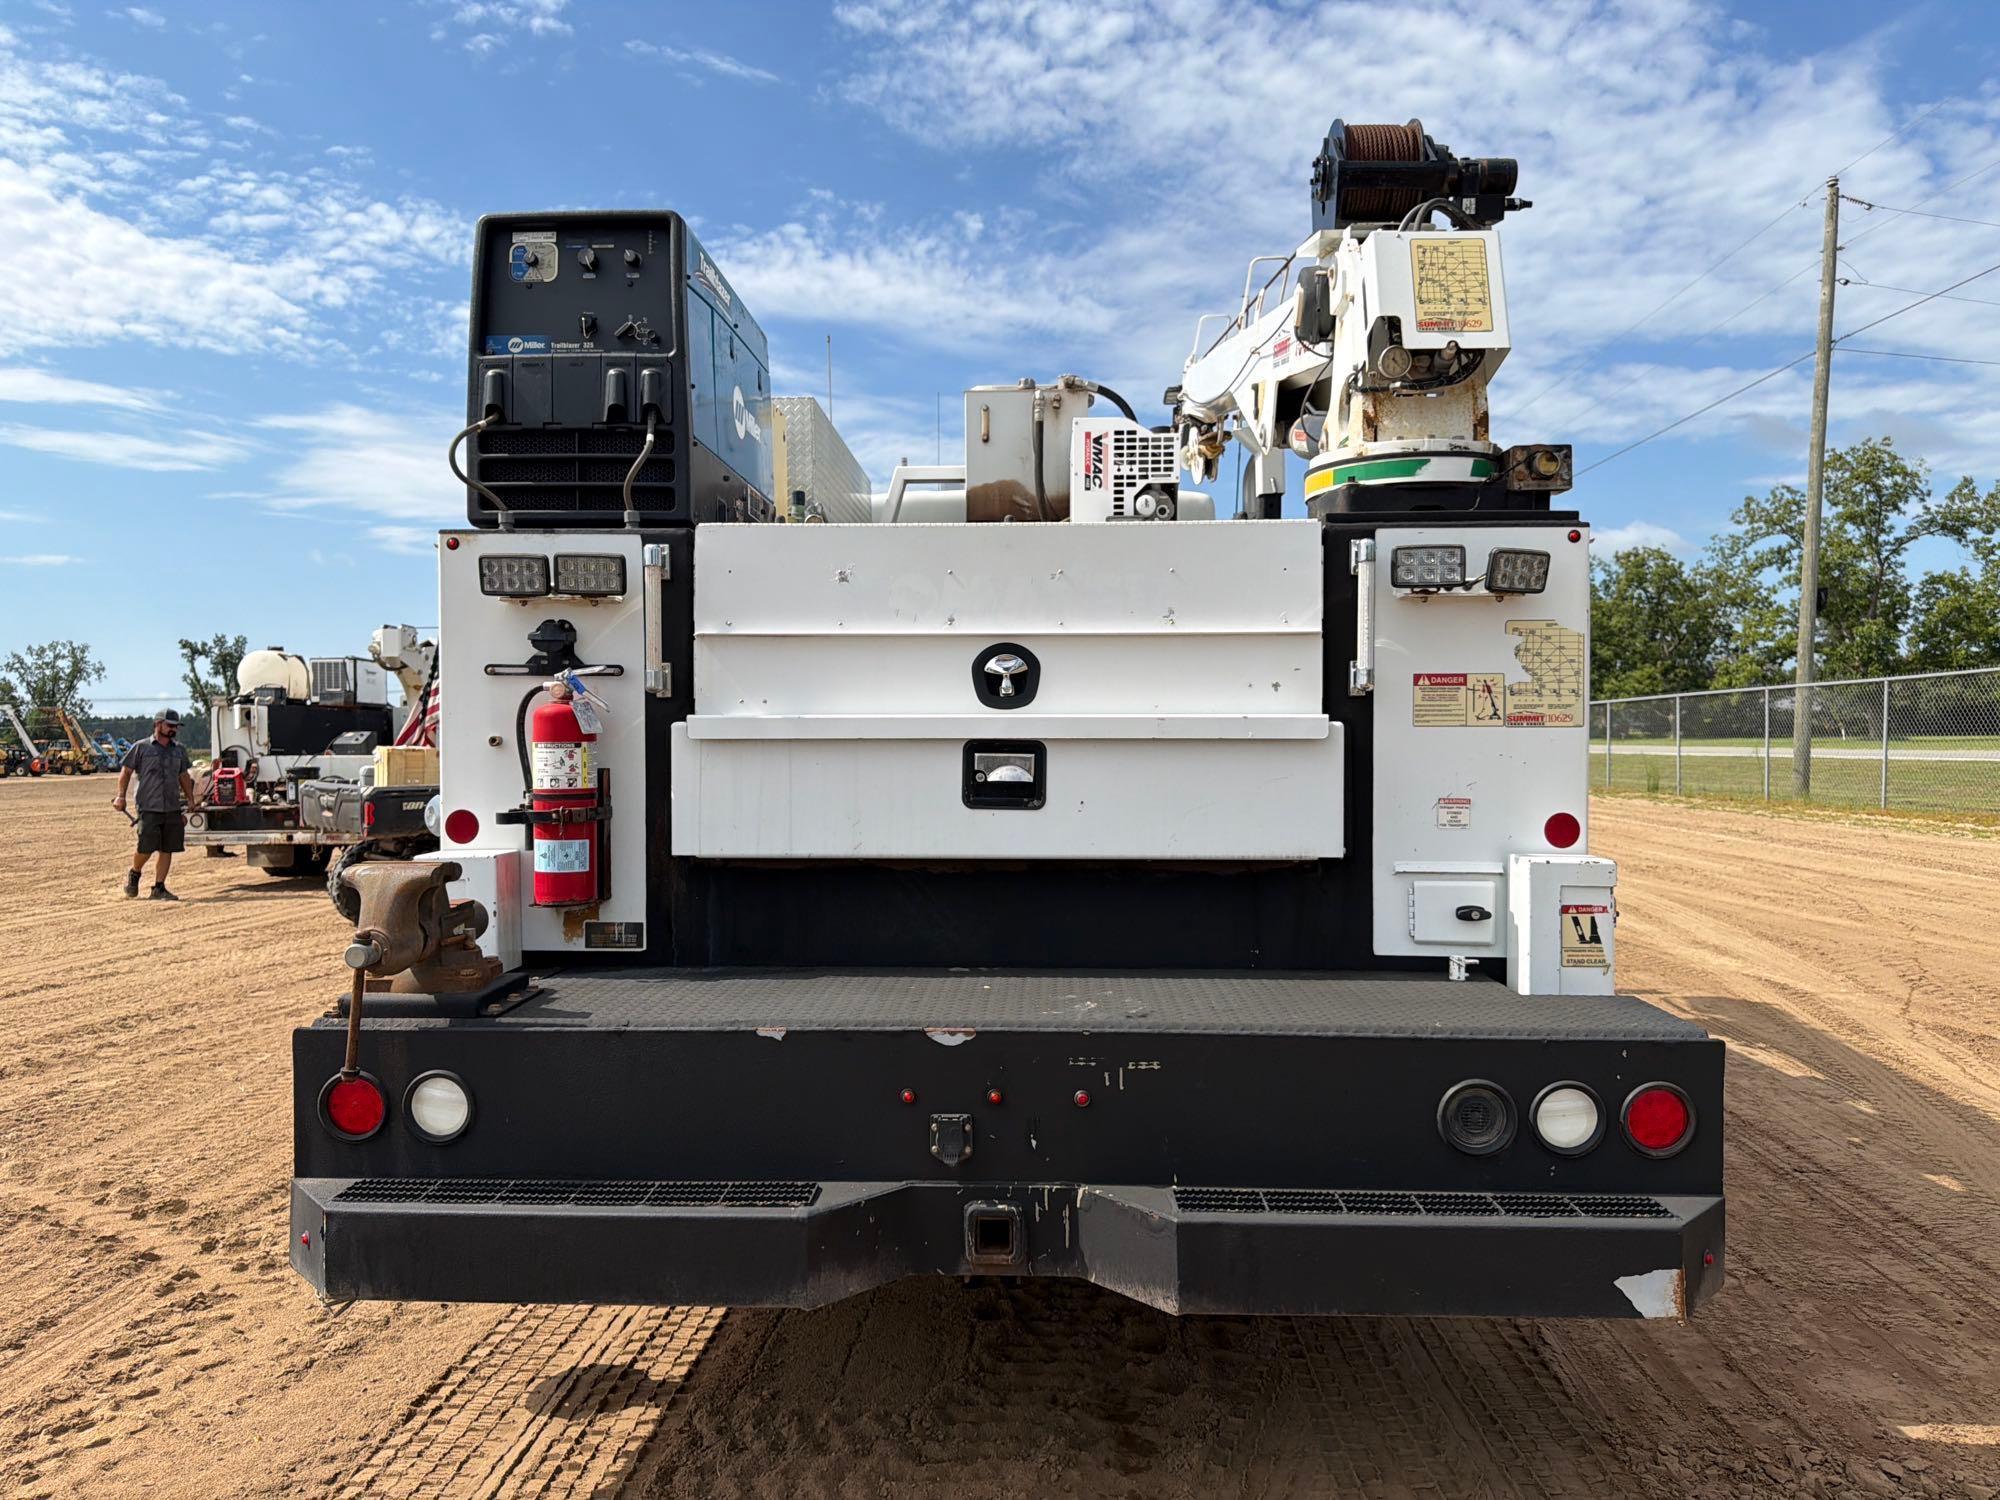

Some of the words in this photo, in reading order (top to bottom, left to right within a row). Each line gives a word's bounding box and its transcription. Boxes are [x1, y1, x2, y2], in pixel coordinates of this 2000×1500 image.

[524, 341, 546, 349] Miller
[551, 341, 581, 349] Trailblazer
[582, 341, 594, 349] 325
[1092, 434, 1103, 489] VMAC
[1430, 676, 1464, 684] DANGER
[1548, 713, 1574, 723] 10629
